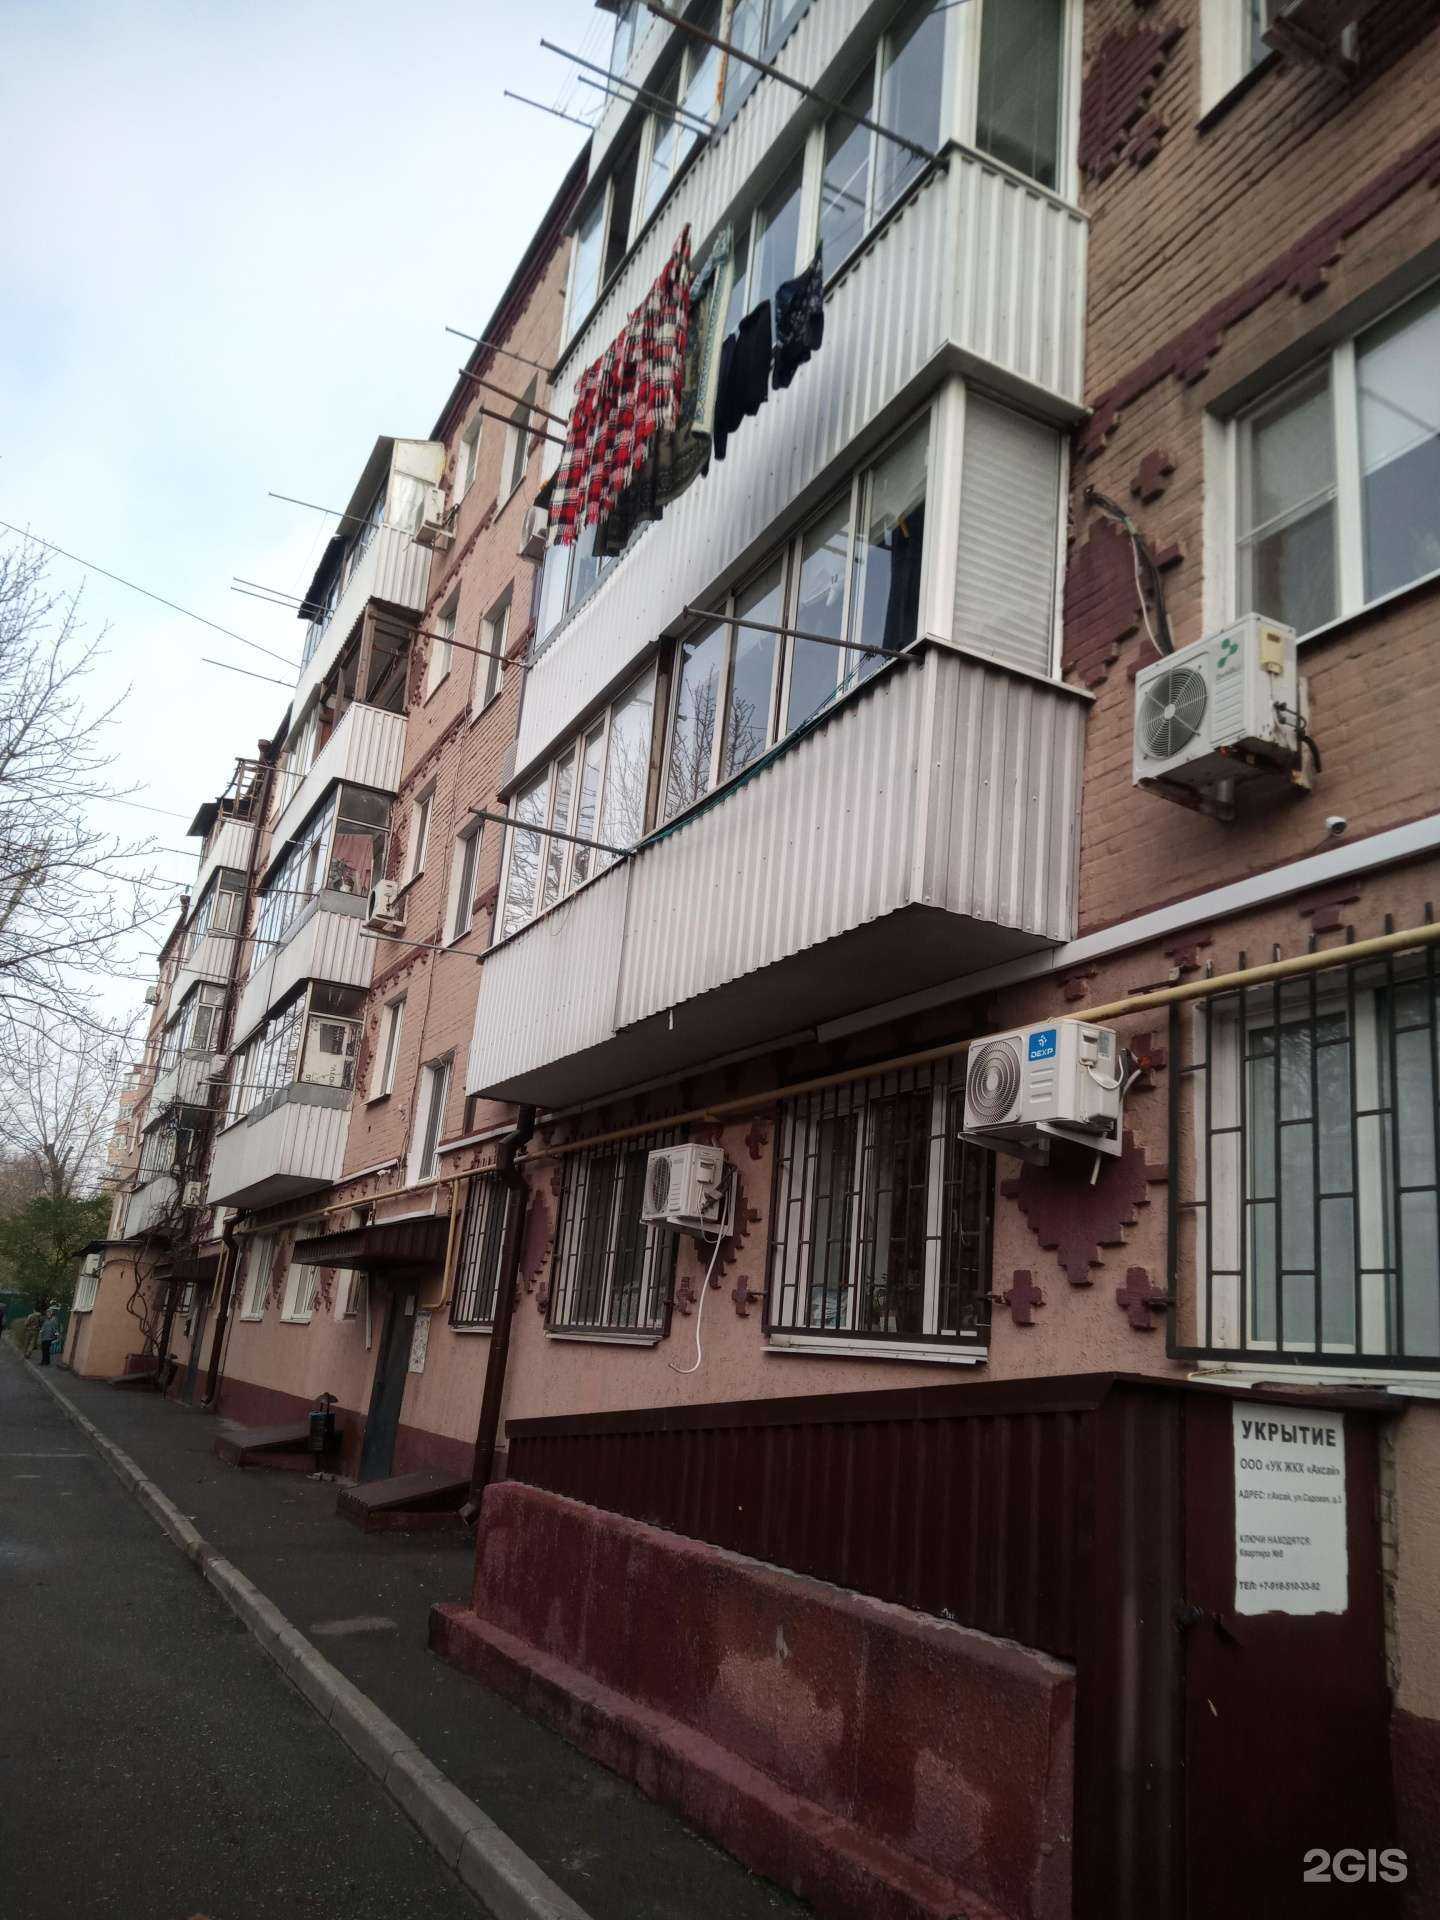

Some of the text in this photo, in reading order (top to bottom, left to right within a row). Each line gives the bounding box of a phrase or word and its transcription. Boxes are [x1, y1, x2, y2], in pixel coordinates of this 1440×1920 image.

[1242, 1420, 1336, 1447] УКРЫТИЕ
[1240, 1458, 1263, 1470] ООО
[1284, 1461, 1305, 1473] ЖКХ
